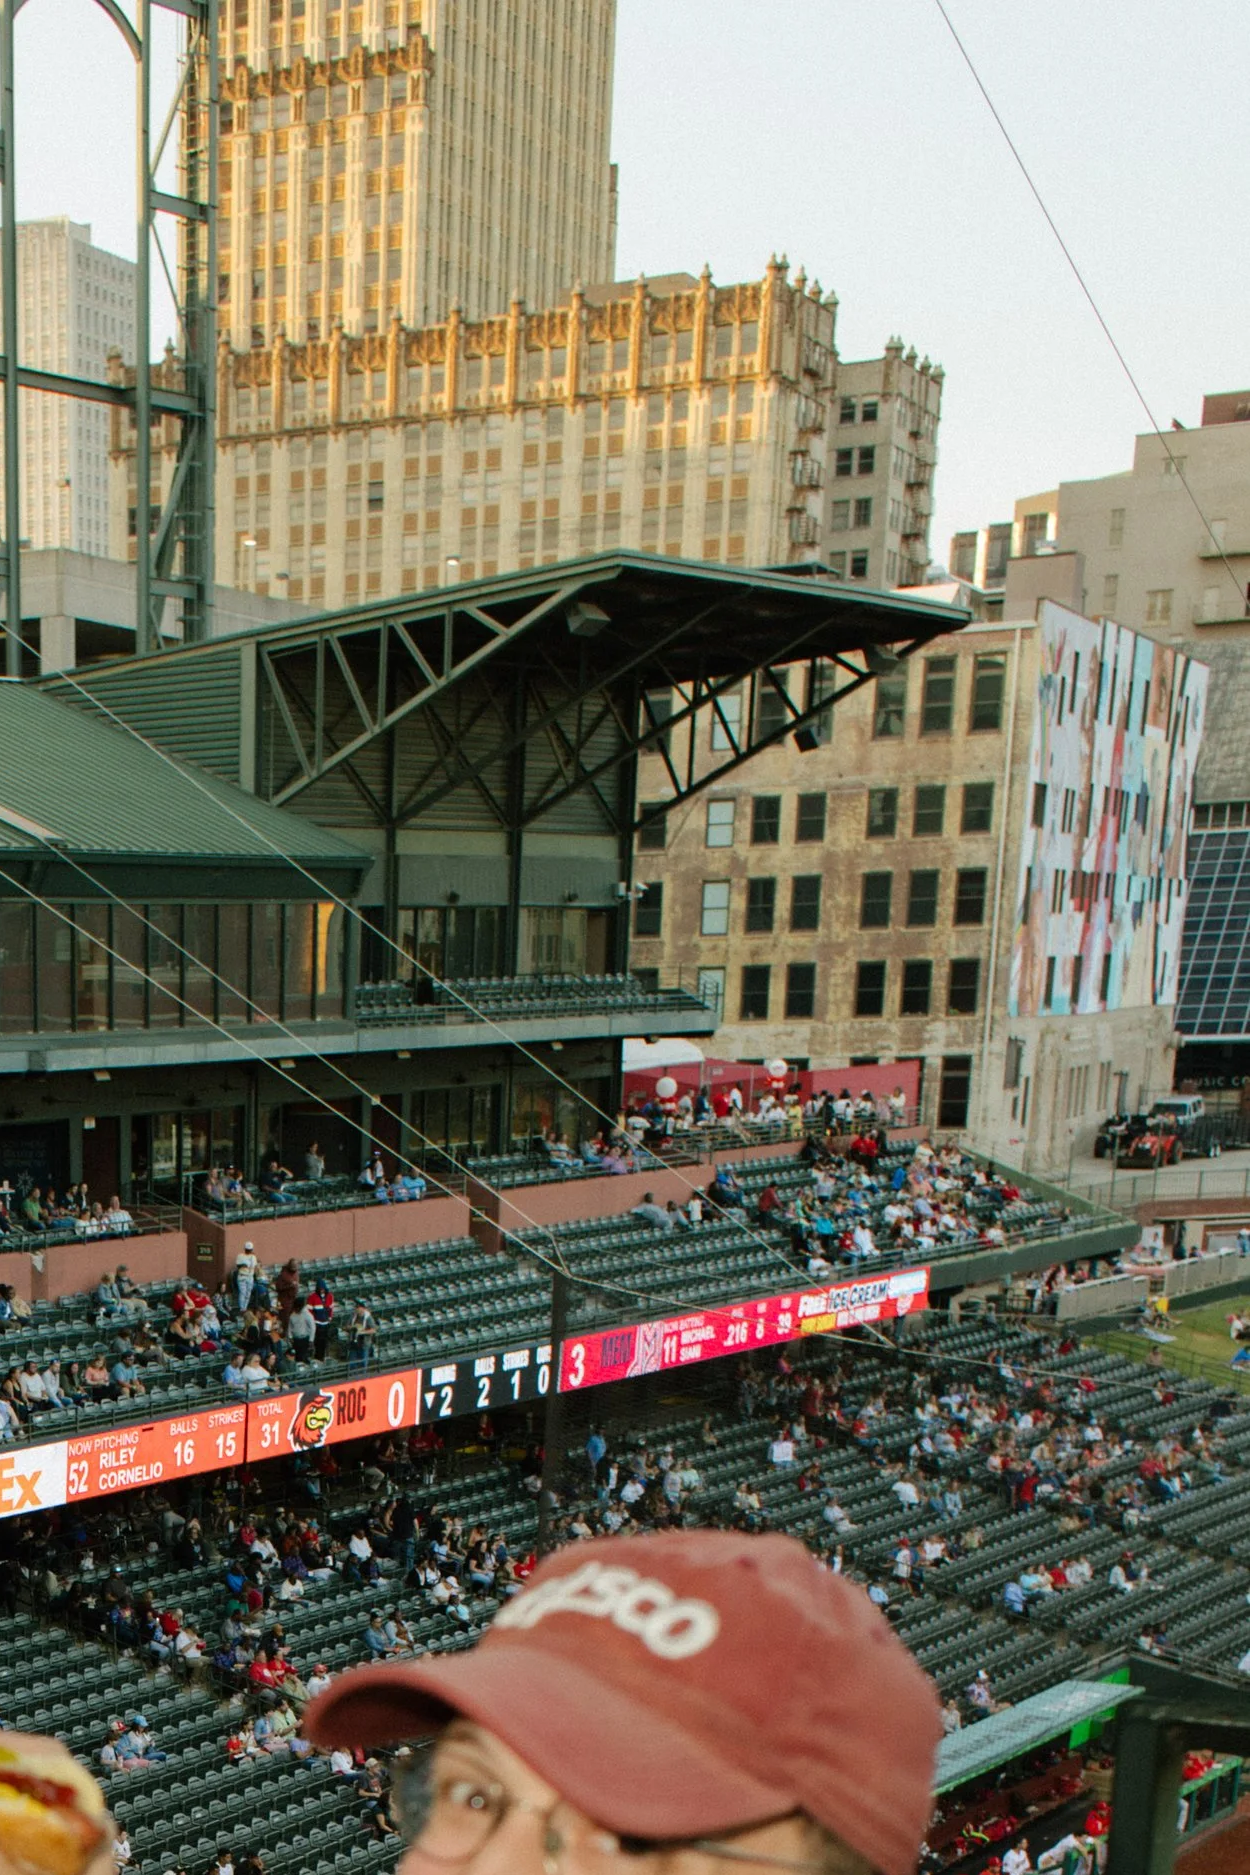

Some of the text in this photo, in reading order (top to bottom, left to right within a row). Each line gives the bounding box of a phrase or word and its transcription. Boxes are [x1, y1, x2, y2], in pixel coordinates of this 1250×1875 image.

[663, 1335, 677, 1363] 11
[568, 1343, 585, 1386] 3
[477, 1377, 491, 1408] 2
[511, 1369, 521, 1400] 1
[537, 1364, 550, 1394] 0
[257, 1402, 283, 1416] TOTAL
[337, 1386, 366, 1425] ROC
[387, 1380, 405, 1427] 0
[439, 1386, 453, 1417] 2
[169, 1419, 198, 1436] BALLS
[208, 1409, 244, 1428] STRIKES
[68, 1431, 139, 1457] NOW PITCHING
[216, 1432, 236, 1458] 15
[261, 1421, 279, 1448] 31
[100, 1447, 136, 1469] RILEY
[173, 1439, 195, 1467] 16
[68, 1460, 89, 1495] 52
[99, 1461, 163, 1490] CORNELIO
